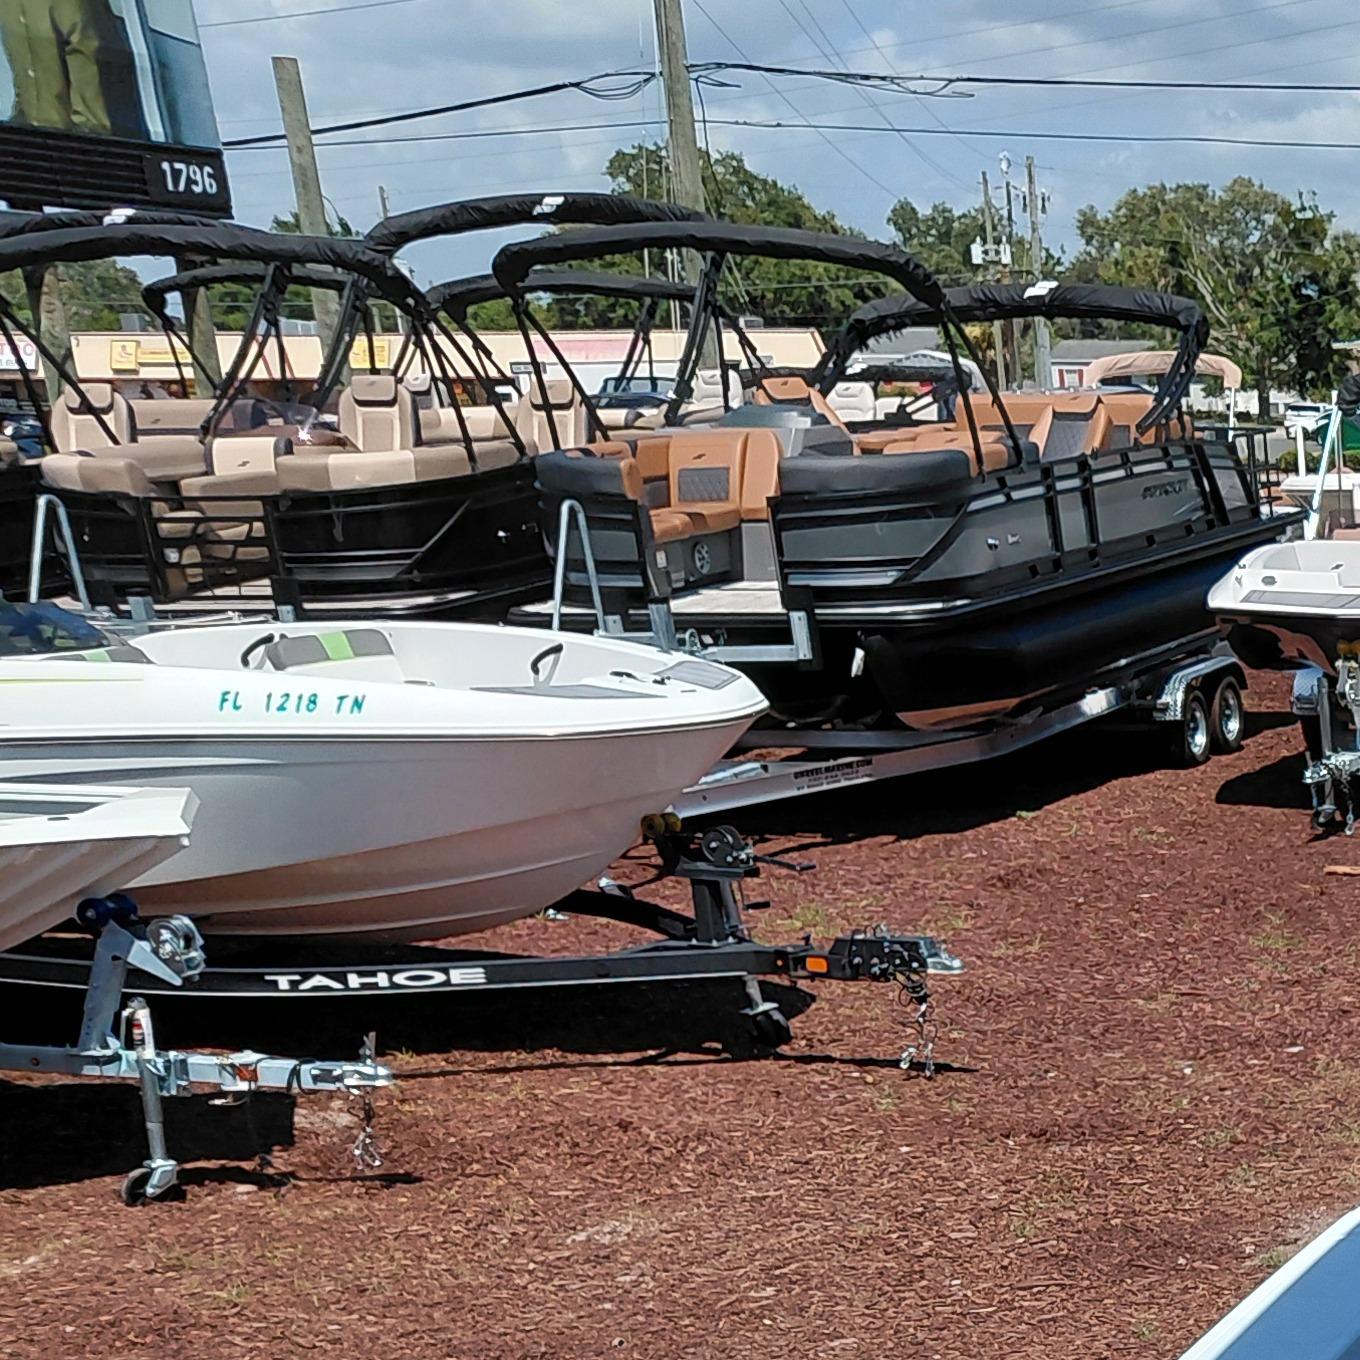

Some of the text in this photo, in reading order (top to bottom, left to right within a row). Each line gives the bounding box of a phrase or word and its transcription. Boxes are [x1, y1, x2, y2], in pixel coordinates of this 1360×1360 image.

[161, 161, 218, 195] 1796
[219, 691, 366, 715] FL 1218 TN
[264, 967, 487, 991] TAHOE
